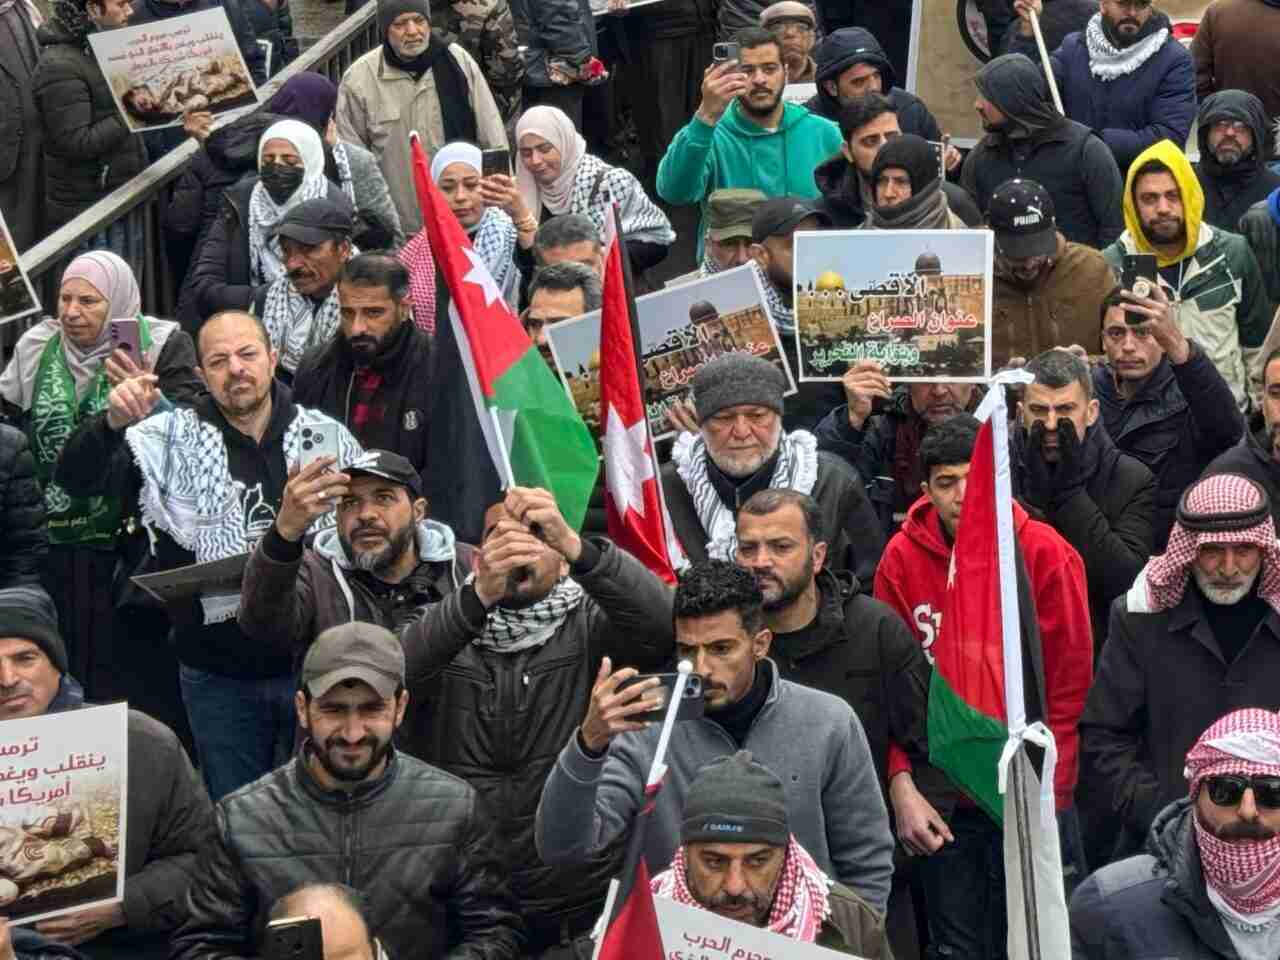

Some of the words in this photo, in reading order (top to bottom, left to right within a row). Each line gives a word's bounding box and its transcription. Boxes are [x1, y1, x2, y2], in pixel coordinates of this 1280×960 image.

[1013, 214, 1040, 227] PUMA
[849, 272, 928, 304] الأقصى
[866, 310, 926, 333] الصراع
[926, 311, 977, 333] عنوان
[866, 340, 920, 366] وبوابة
[43, 753, 106, 779] ينقلب
[9, 775, 71, 806] أمريكا
[683, 932, 731, 954] الحرب
